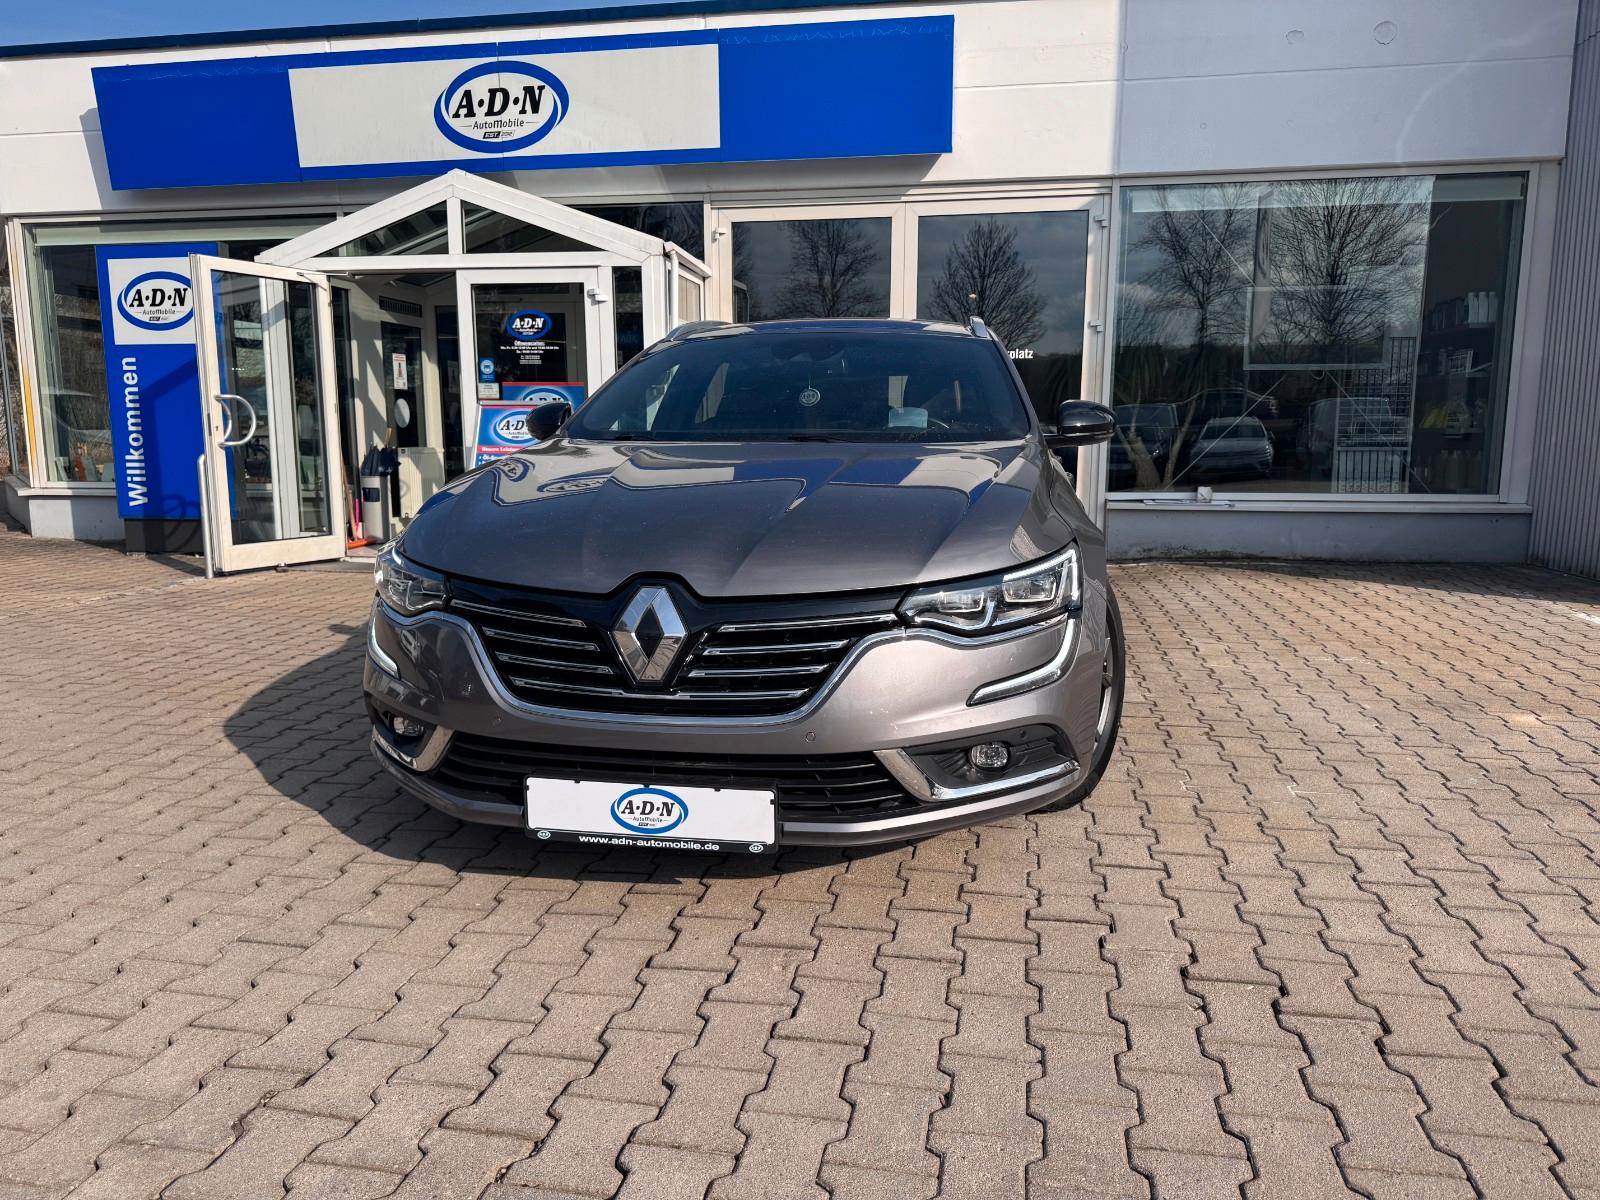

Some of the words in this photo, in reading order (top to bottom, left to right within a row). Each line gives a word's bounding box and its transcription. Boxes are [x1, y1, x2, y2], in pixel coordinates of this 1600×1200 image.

[473, 118, 525, 130] AutoMobile
[121, 356, 149, 507] Willkommen
[578, 835, 720, 851] www.adn-automobile.de
